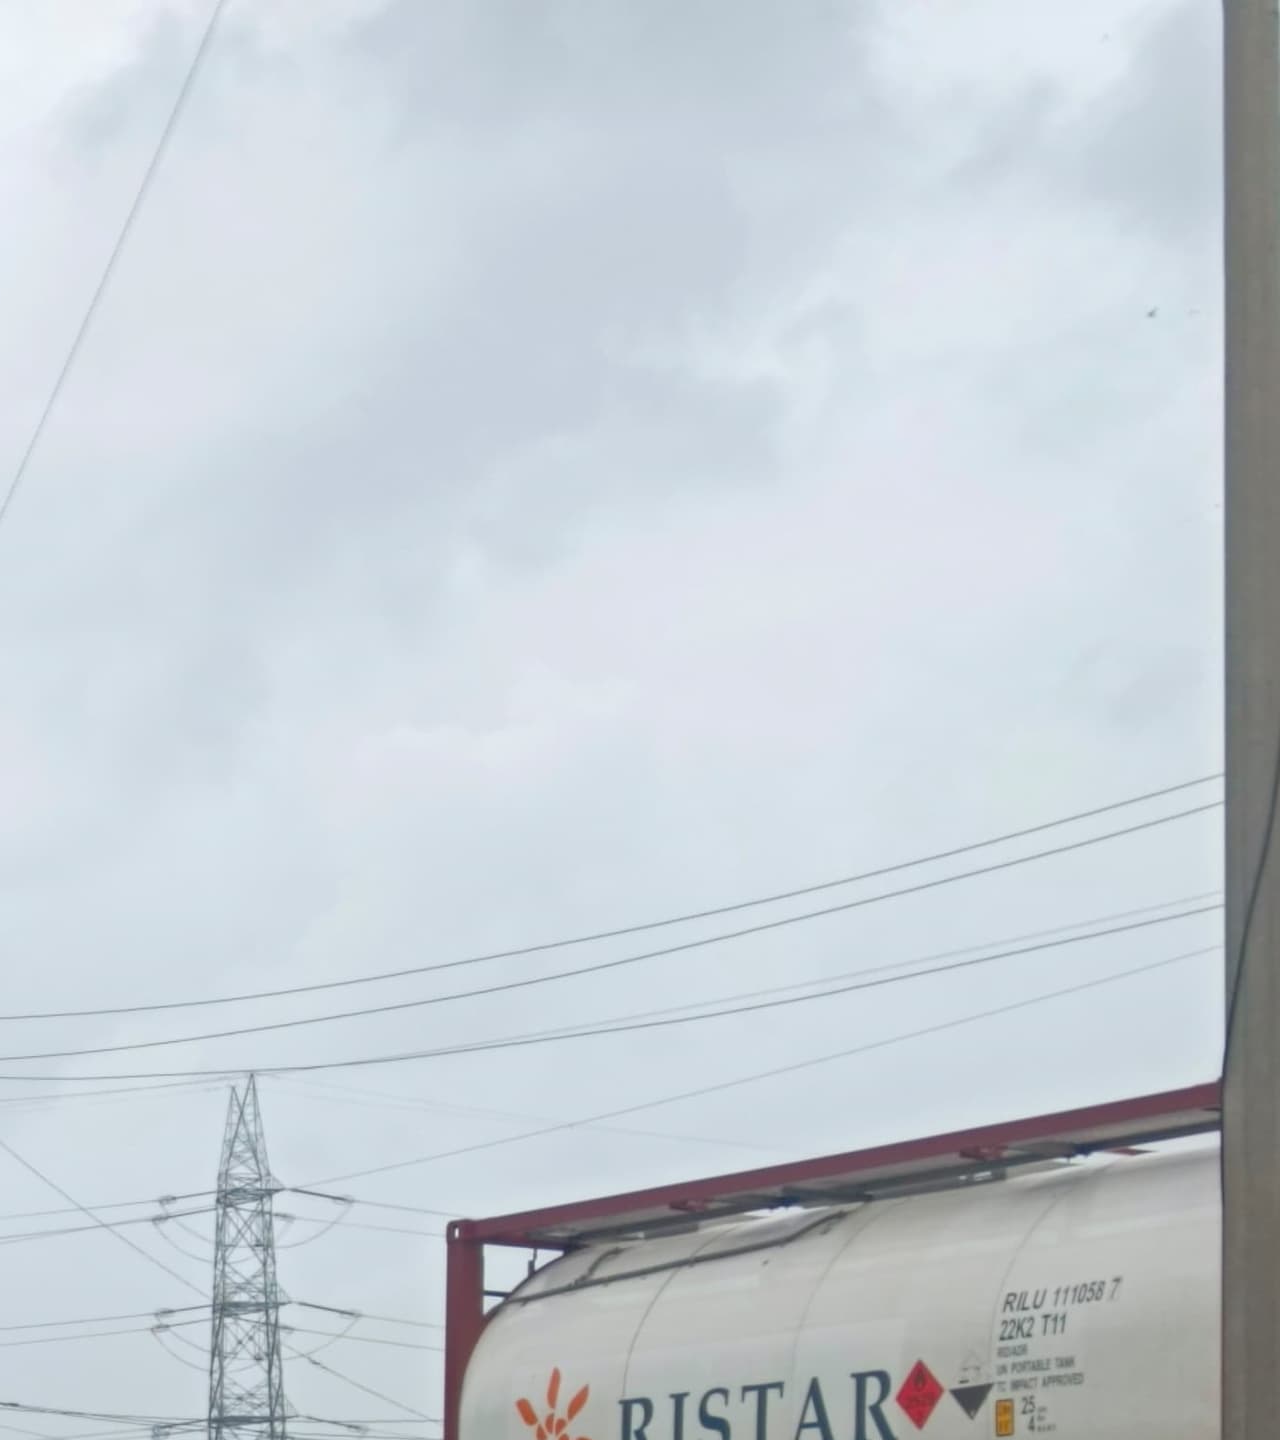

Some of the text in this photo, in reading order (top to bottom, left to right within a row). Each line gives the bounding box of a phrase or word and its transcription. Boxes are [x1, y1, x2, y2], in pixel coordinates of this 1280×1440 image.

[1002, 1276, 1123, 1313] RILU 111058 7
[999, 1312, 1067, 1341] 22K2 T11
